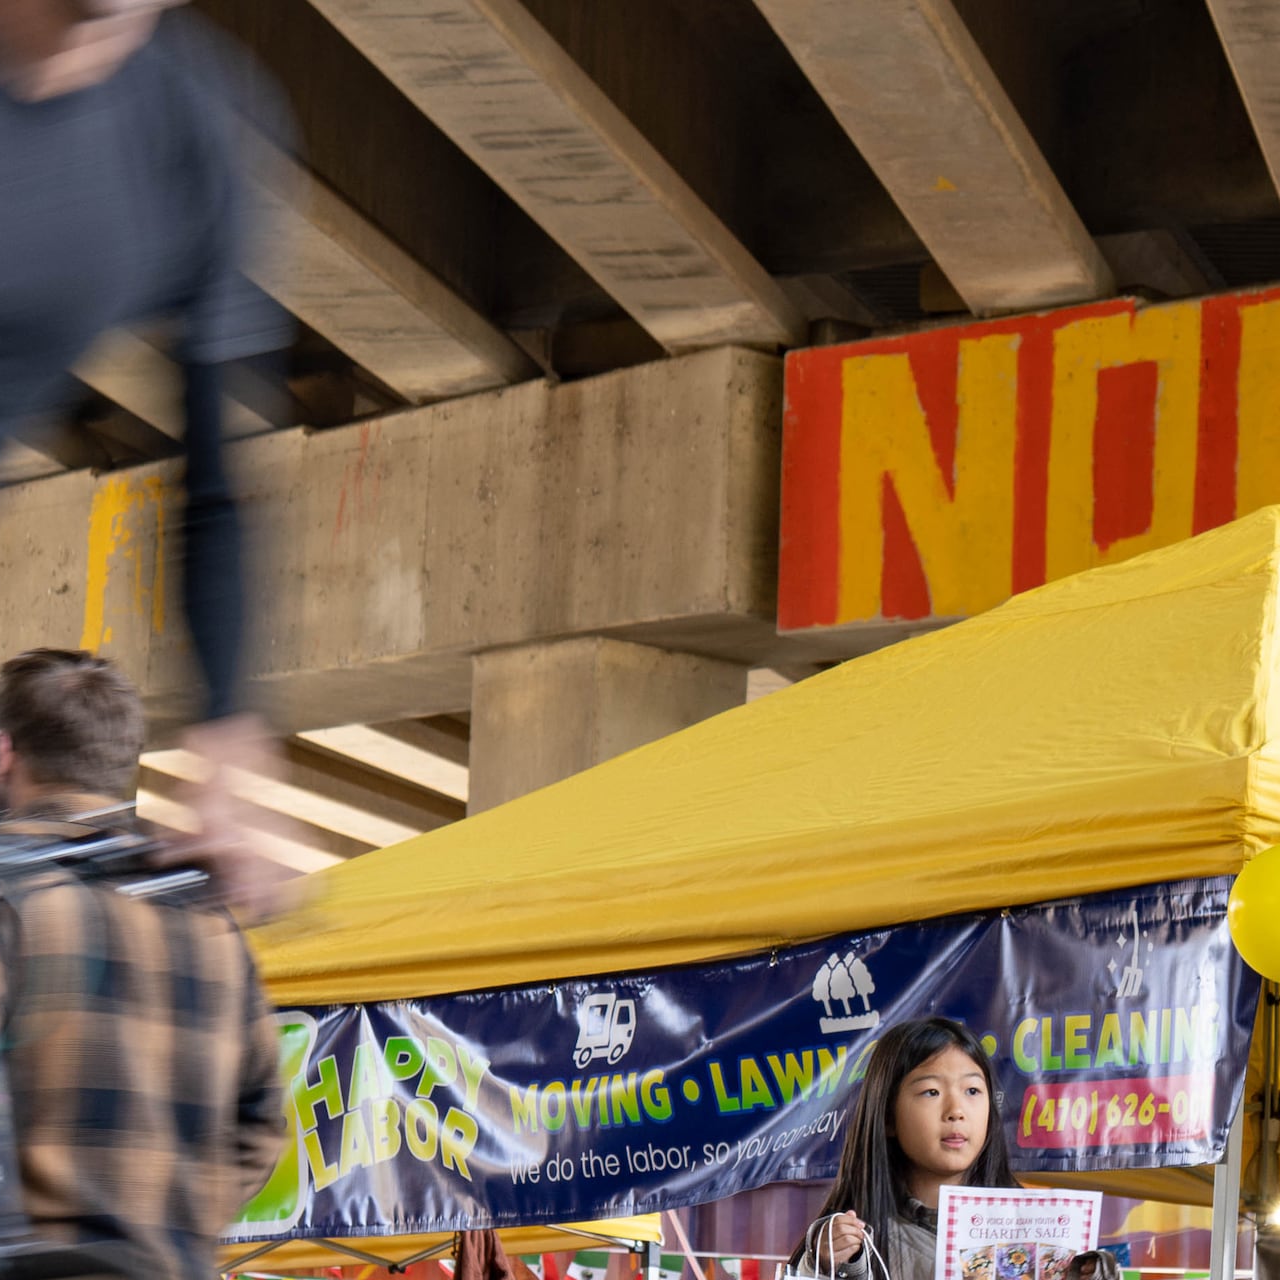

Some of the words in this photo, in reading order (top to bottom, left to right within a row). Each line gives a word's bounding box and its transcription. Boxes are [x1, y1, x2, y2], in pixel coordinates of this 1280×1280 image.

[291, 1037, 490, 1134] HAPPY
[509, 1069, 672, 1134] MOVING
[709, 1046, 847, 1112] LAWN
[1023, 1090, 1098, 1137] (470)
[1106, 1090, 1206, 1127] 626-0
[303, 1098, 479, 1192] LABOR
[510, 1155, 540, 1184] We
[547, 1152, 574, 1182] do
[581, 1149, 620, 1178] the
[626, 1143, 696, 1173] labor,
[703, 1143, 730, 1166] so
[732, 1134, 773, 1170] you
[803, 1109, 847, 1142] stay
[969, 1227, 1031, 1239] CHARITY
[1034, 1227, 1070, 1239] SALE
